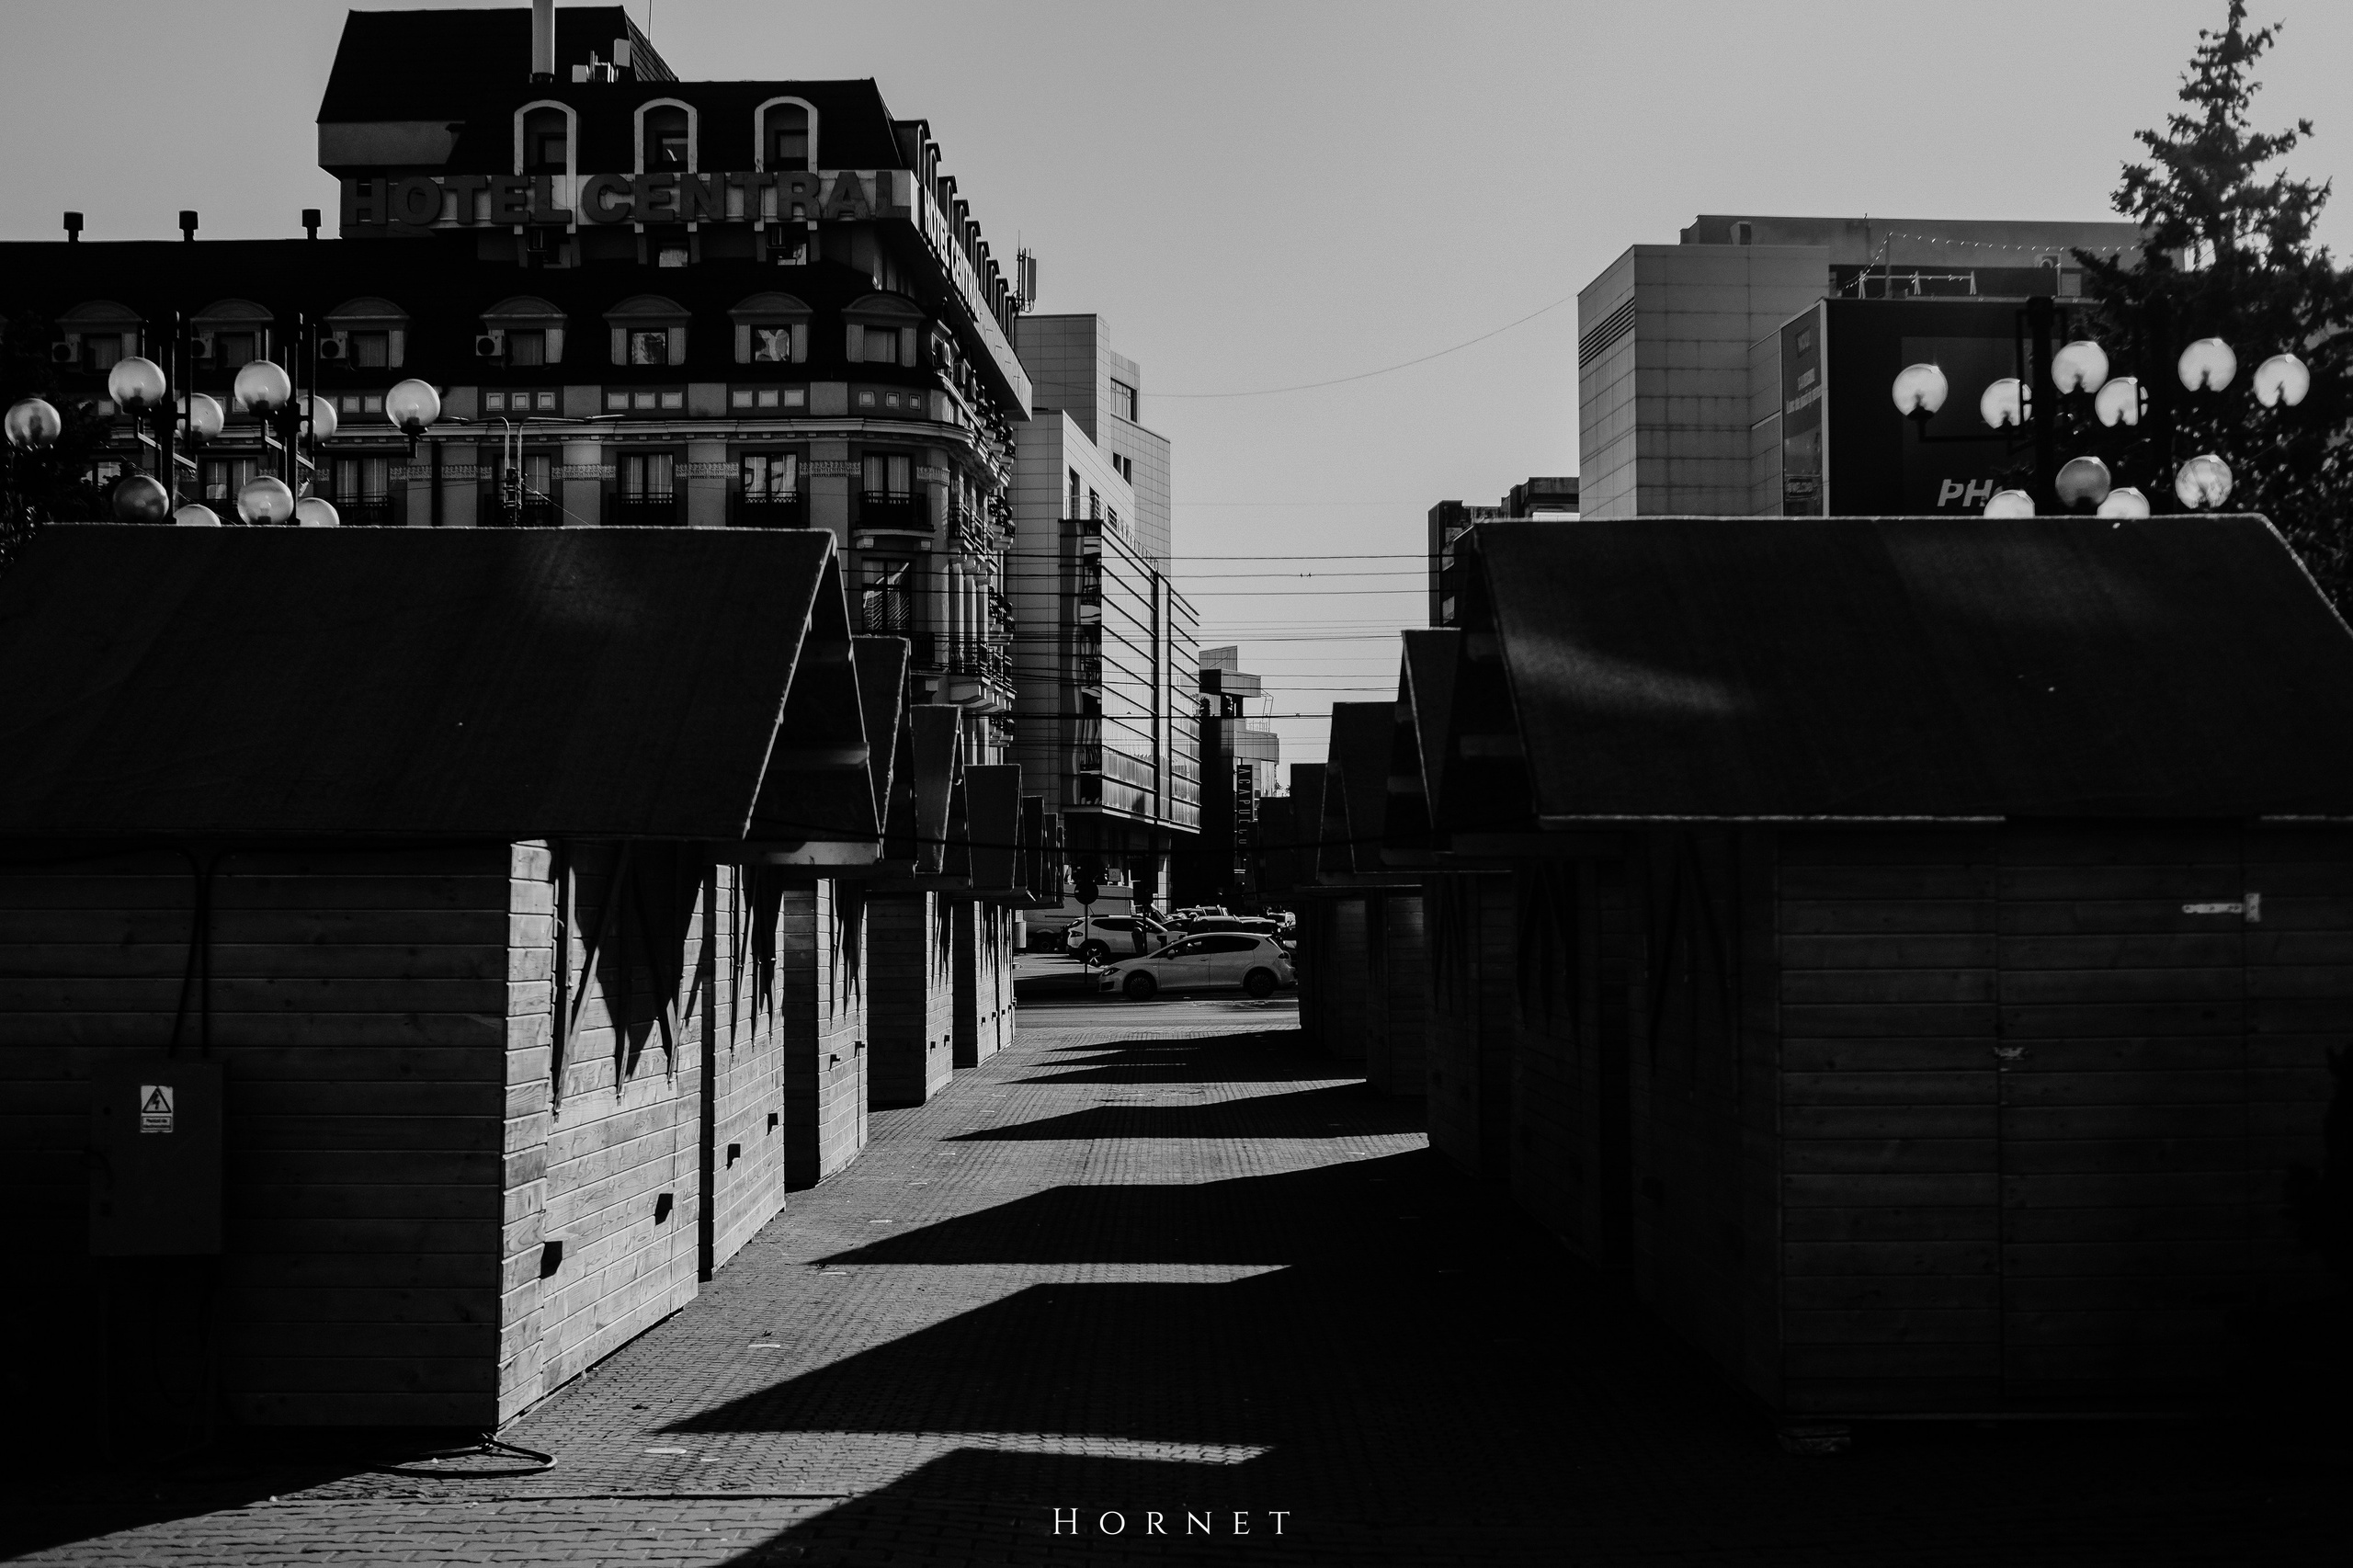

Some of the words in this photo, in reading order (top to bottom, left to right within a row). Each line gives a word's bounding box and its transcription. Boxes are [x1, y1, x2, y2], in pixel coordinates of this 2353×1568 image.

[341, 174, 572, 226] HOTEL
[582, 171, 911, 223] CENTRAL
[924, 183, 949, 269] HOTEL
[950, 233, 981, 323] CENTRAL
[1937, 479, 2003, 507] PH
